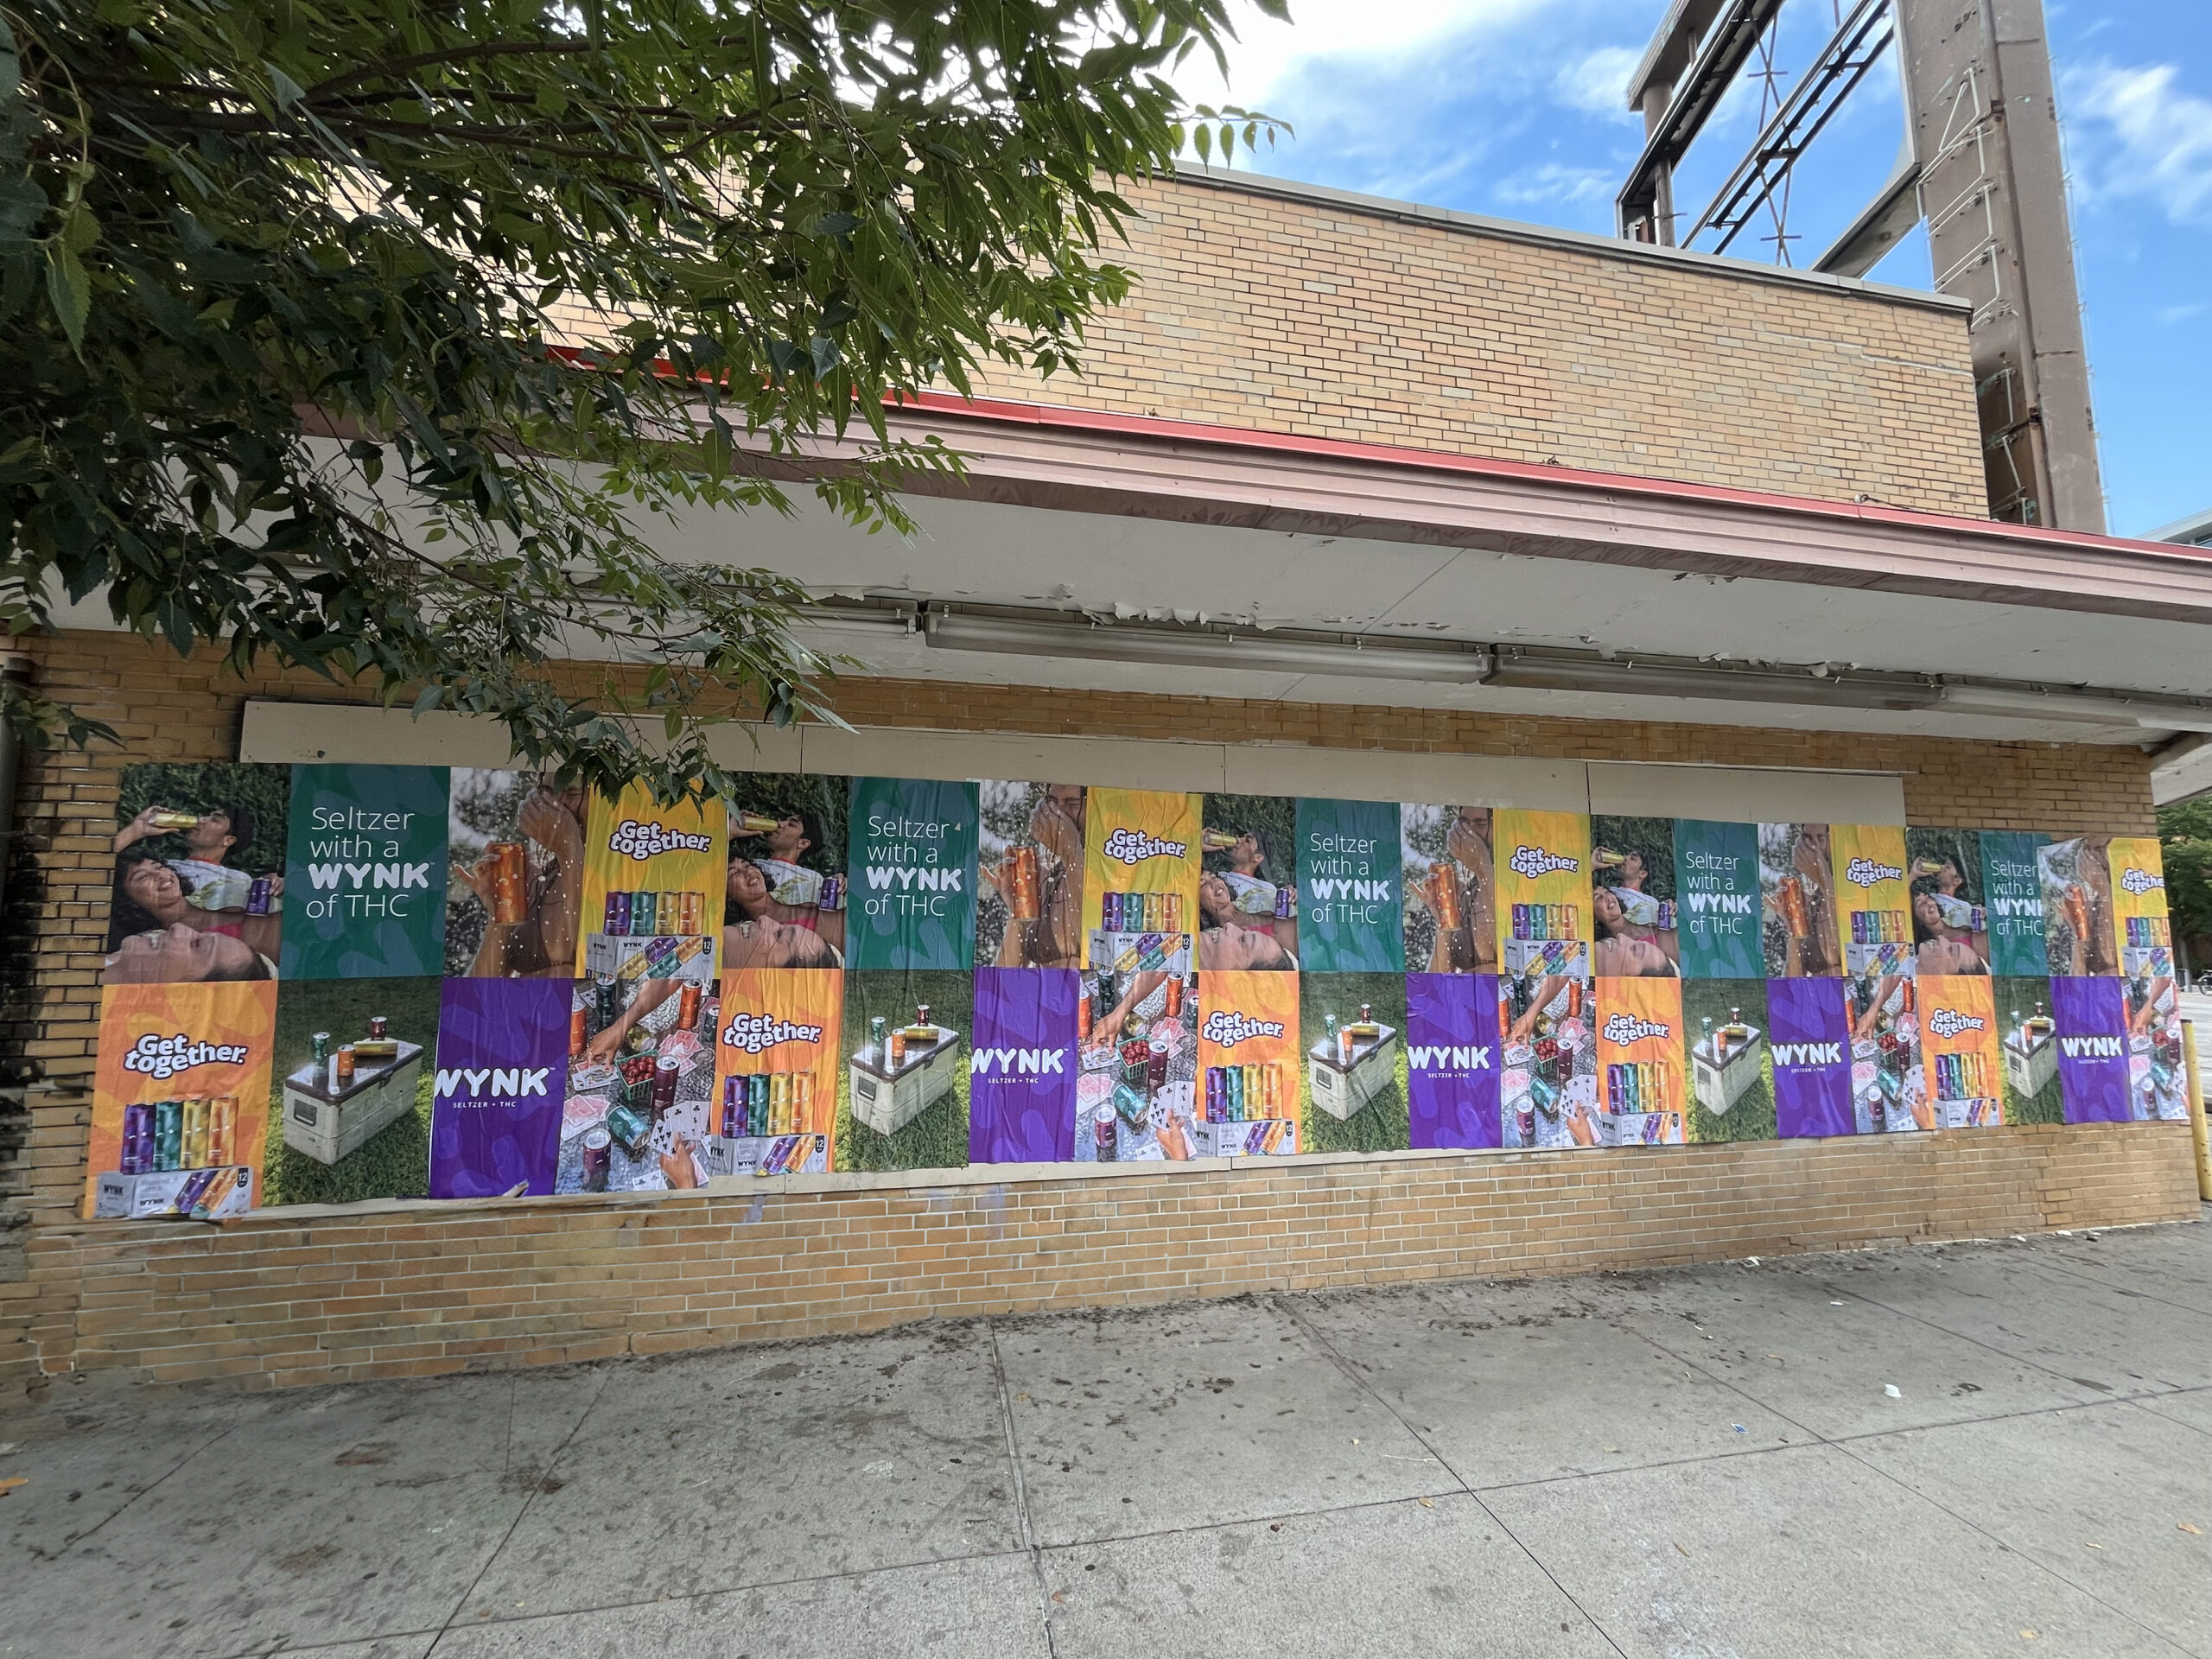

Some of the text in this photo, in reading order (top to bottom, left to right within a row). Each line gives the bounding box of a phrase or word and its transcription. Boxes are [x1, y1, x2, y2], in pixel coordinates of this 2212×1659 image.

[310, 806, 415, 830] Seltzer
[868, 816, 950, 839] Seltzer
[619, 820, 662, 840] Get
[1111, 829, 1147, 847] Get
[309, 834, 399, 858] with a
[609, 830, 711, 861] together.
[867, 841, 938, 863] with a
[1104, 837, 1186, 864] together.
[1310, 832, 1378, 854] Seltzer
[1516, 845, 1545, 862] Get
[1310, 855, 1369, 876] with a
[1510, 853, 1579, 879] together.
[1686, 851, 1739, 870] Seltzer
[1851, 857, 1874, 873] Get
[1990, 860, 2037, 877] Seltzer
[308, 862, 429, 890] WYNK
[866, 865, 962, 892] WYNK
[1687, 872, 1734, 891] with a
[1846, 864, 1902, 887] together.
[2125, 868, 2145, 881] Get
[1310, 878, 1390, 901] WYNK
[1993, 879, 2034, 896] with a
[306, 893, 410, 918] of THC
[864, 893, 946, 917] of THC
[1312, 903, 1378, 924] of THC
[1688, 893, 1752, 914] WYNK
[1690, 915, 1743, 935] of THC
[1996, 918, 2044, 937] of THC
[703, 941, 712, 950] 12
[733, 1013, 773, 1033] Get
[1209, 1010, 1243, 1029] Get
[1609, 1013, 1637, 1029] Get
[1933, 1008, 1957, 1023] Get
[723, 1020, 822, 1052] together.
[1202, 1018, 1284, 1047] together.
[1603, 1020, 1670, 1046] together.
[137, 1034, 188, 1057] Get
[1771, 1042, 1842, 1066] WYNK
[2061, 1037, 2123, 1058] WYNK
[124, 1041, 248, 1079] together.
[971, 1047, 1065, 1074] WYNK
[1407, 1046, 1491, 1070] WYNK
[434, 1067, 550, 1097] WYNK
[816, 1139, 823, 1147] 12
[238, 1173, 249, 1183] 12
